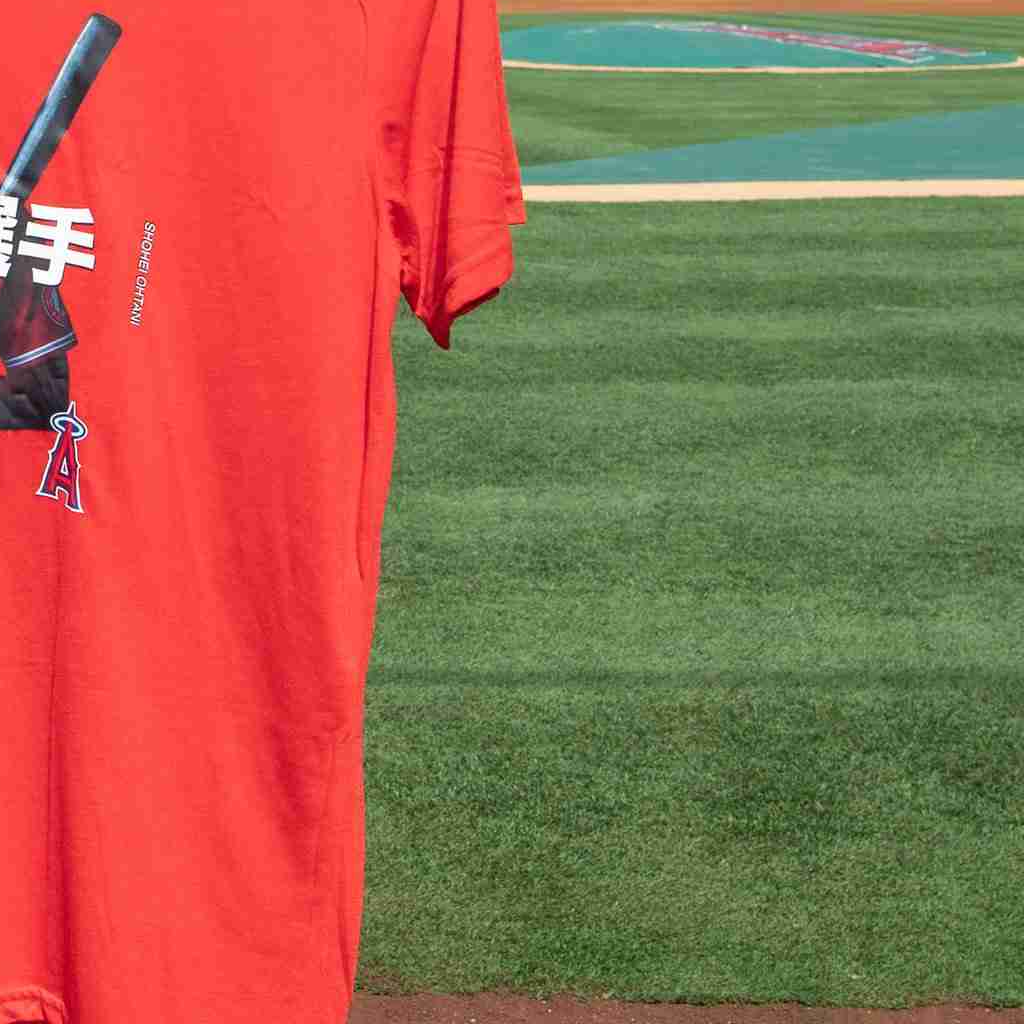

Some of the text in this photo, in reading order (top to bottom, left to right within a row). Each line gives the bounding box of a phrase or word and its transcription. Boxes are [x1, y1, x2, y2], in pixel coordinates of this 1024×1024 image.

[130, 222, 157, 328] SHOHEI OHTANI
[35, 400, 88, 513] A
